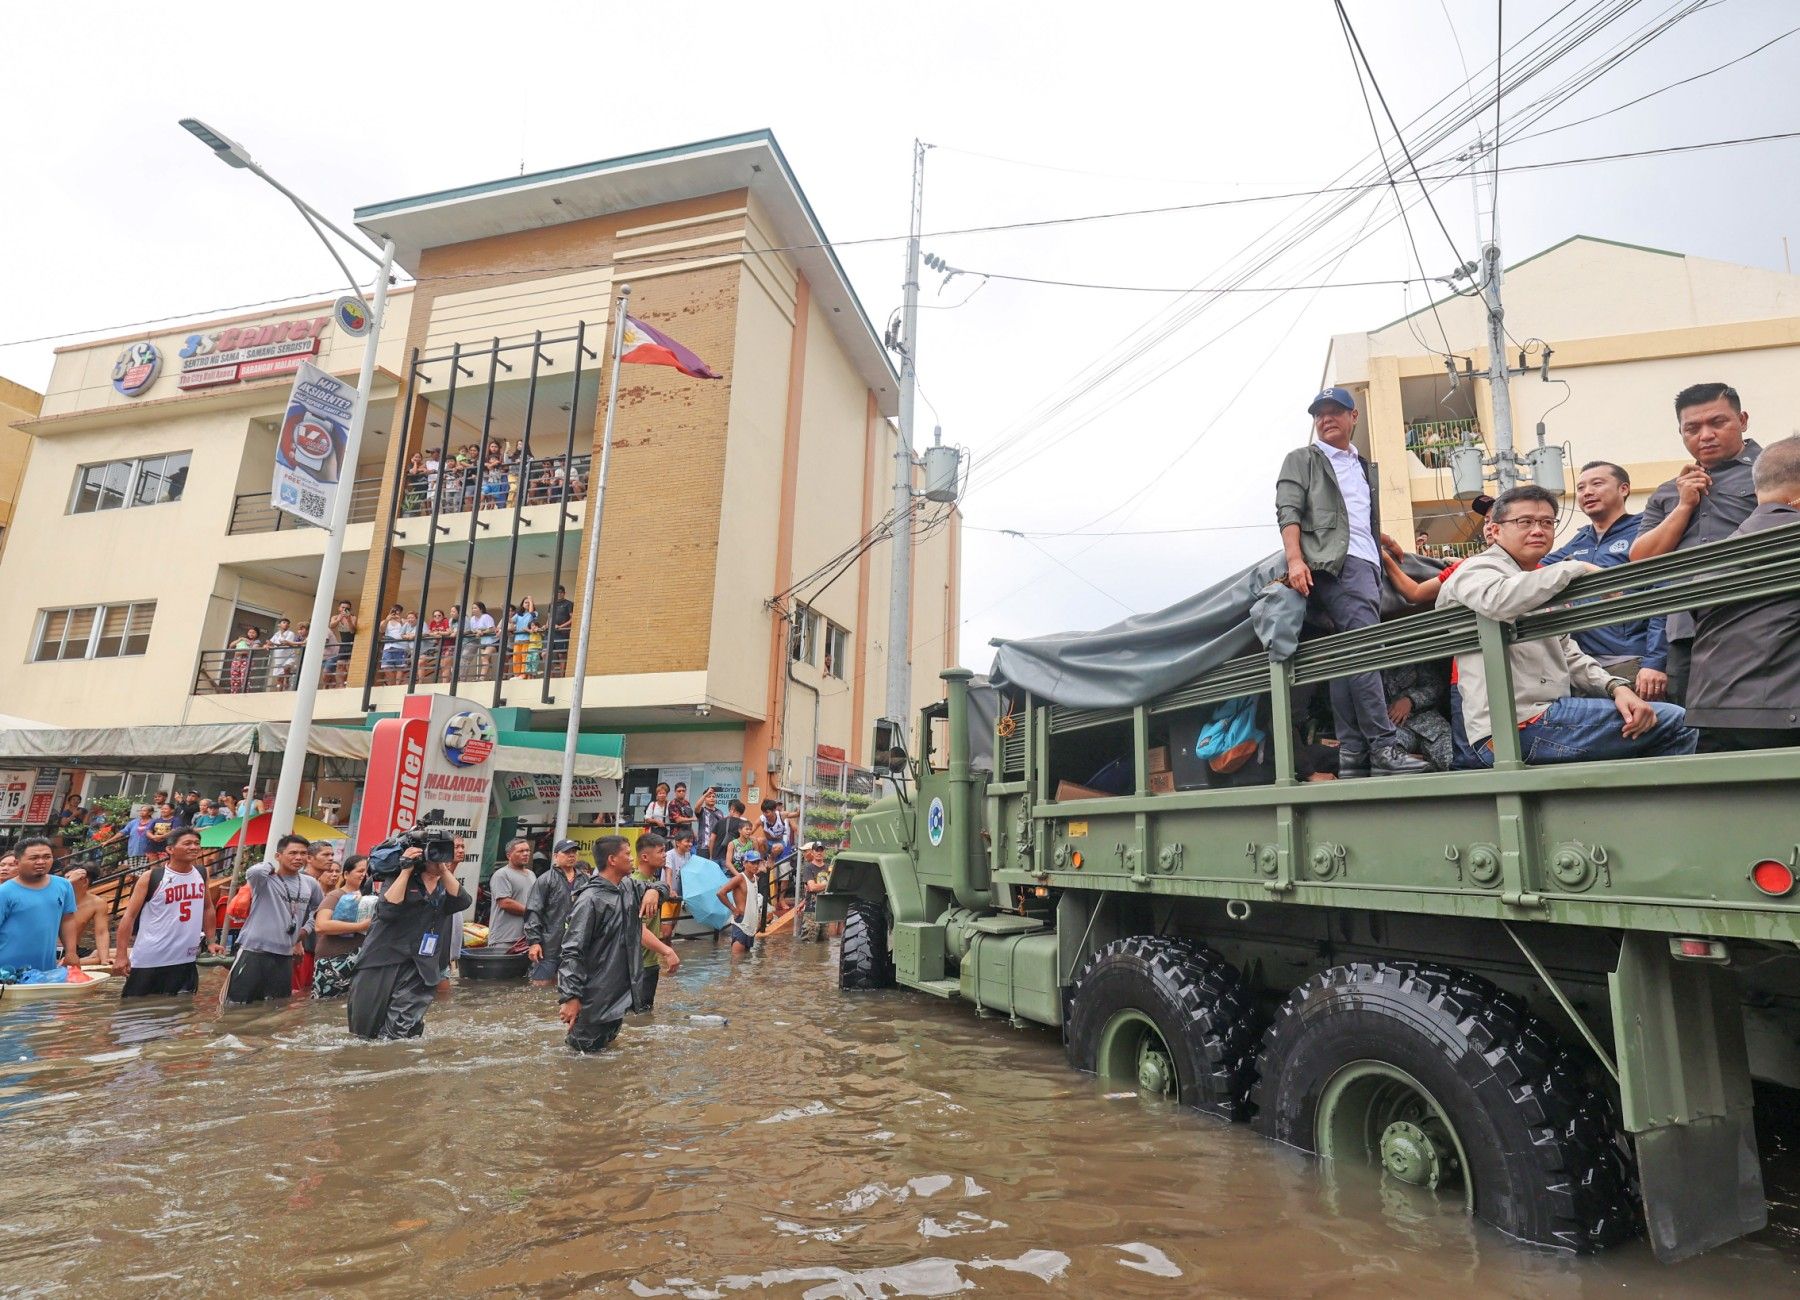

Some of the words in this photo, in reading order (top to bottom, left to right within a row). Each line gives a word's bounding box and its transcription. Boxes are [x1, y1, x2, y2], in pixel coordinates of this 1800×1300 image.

[216, 317, 330, 351] Center
[317, 378, 341, 392] MAY
[298, 382, 352, 410] AKSIDENTE?
[424, 773, 490, 793] MALANDAY
[8, 792, 20, 807] 15
[456, 817, 471, 827] HALL
[165, 883, 205, 905] BULLS
[179, 901, 192, 922] 5
